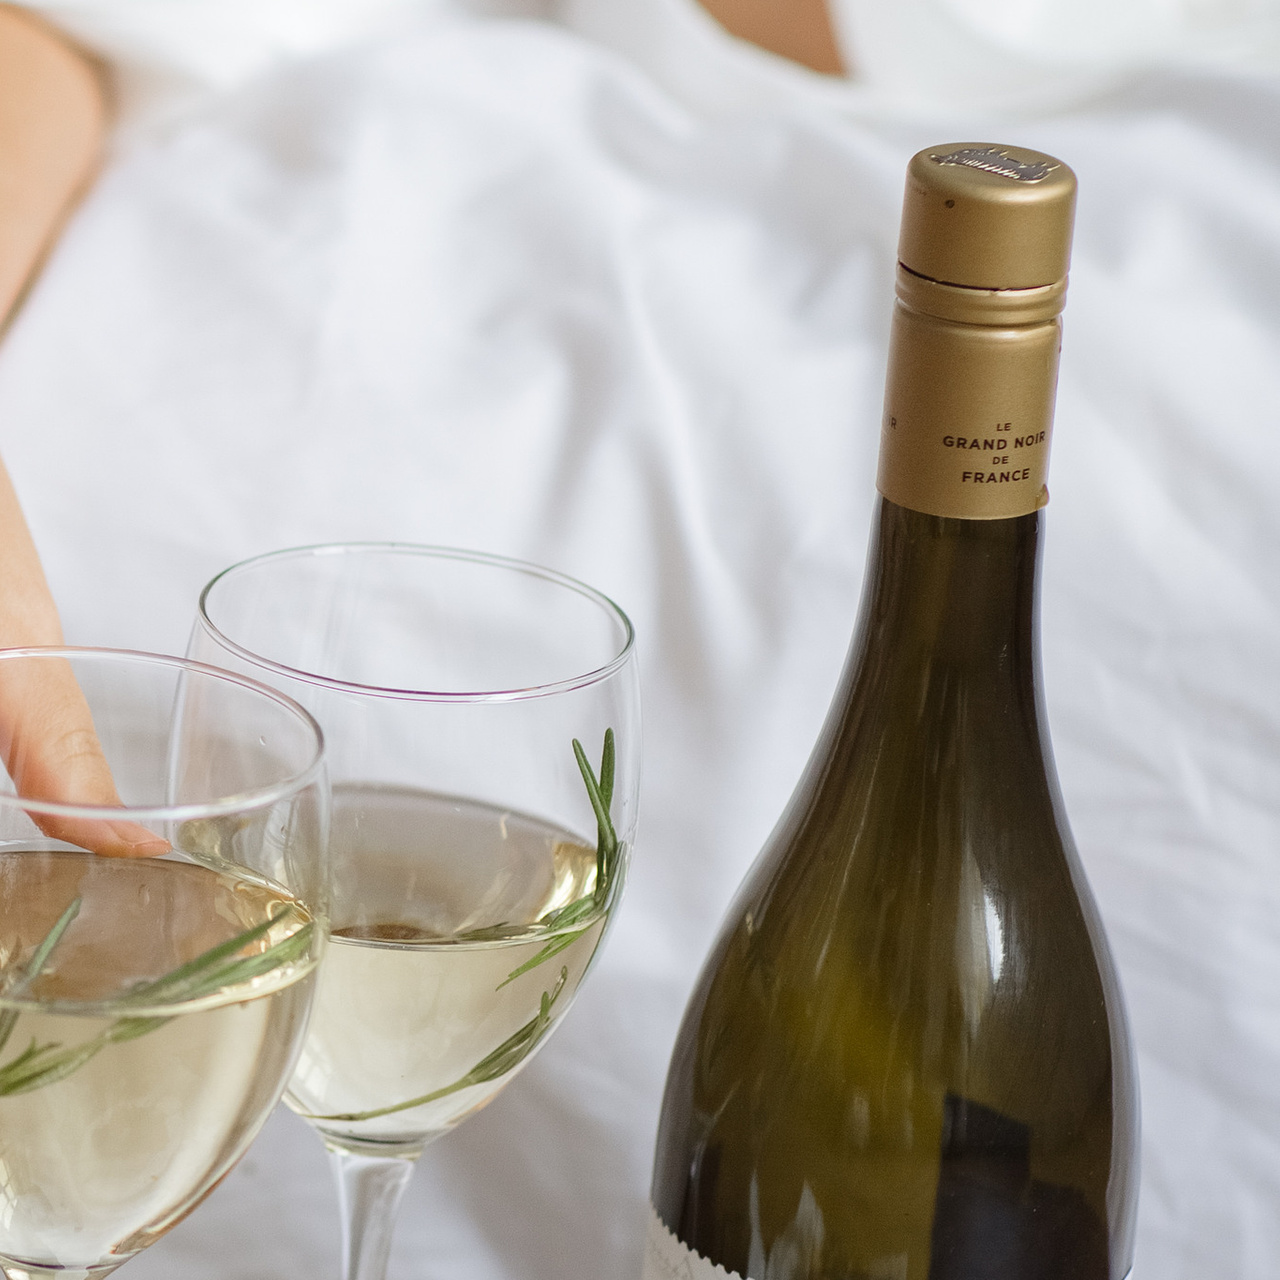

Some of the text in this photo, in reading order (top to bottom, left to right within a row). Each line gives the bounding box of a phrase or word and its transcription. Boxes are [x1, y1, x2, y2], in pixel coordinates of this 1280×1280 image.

[996, 422, 1012, 432] LE
[943, 430, 1046, 451] GRAND NOIR
[992, 456, 1009, 465] DE
[962, 468, 1030, 484] FRANCE
